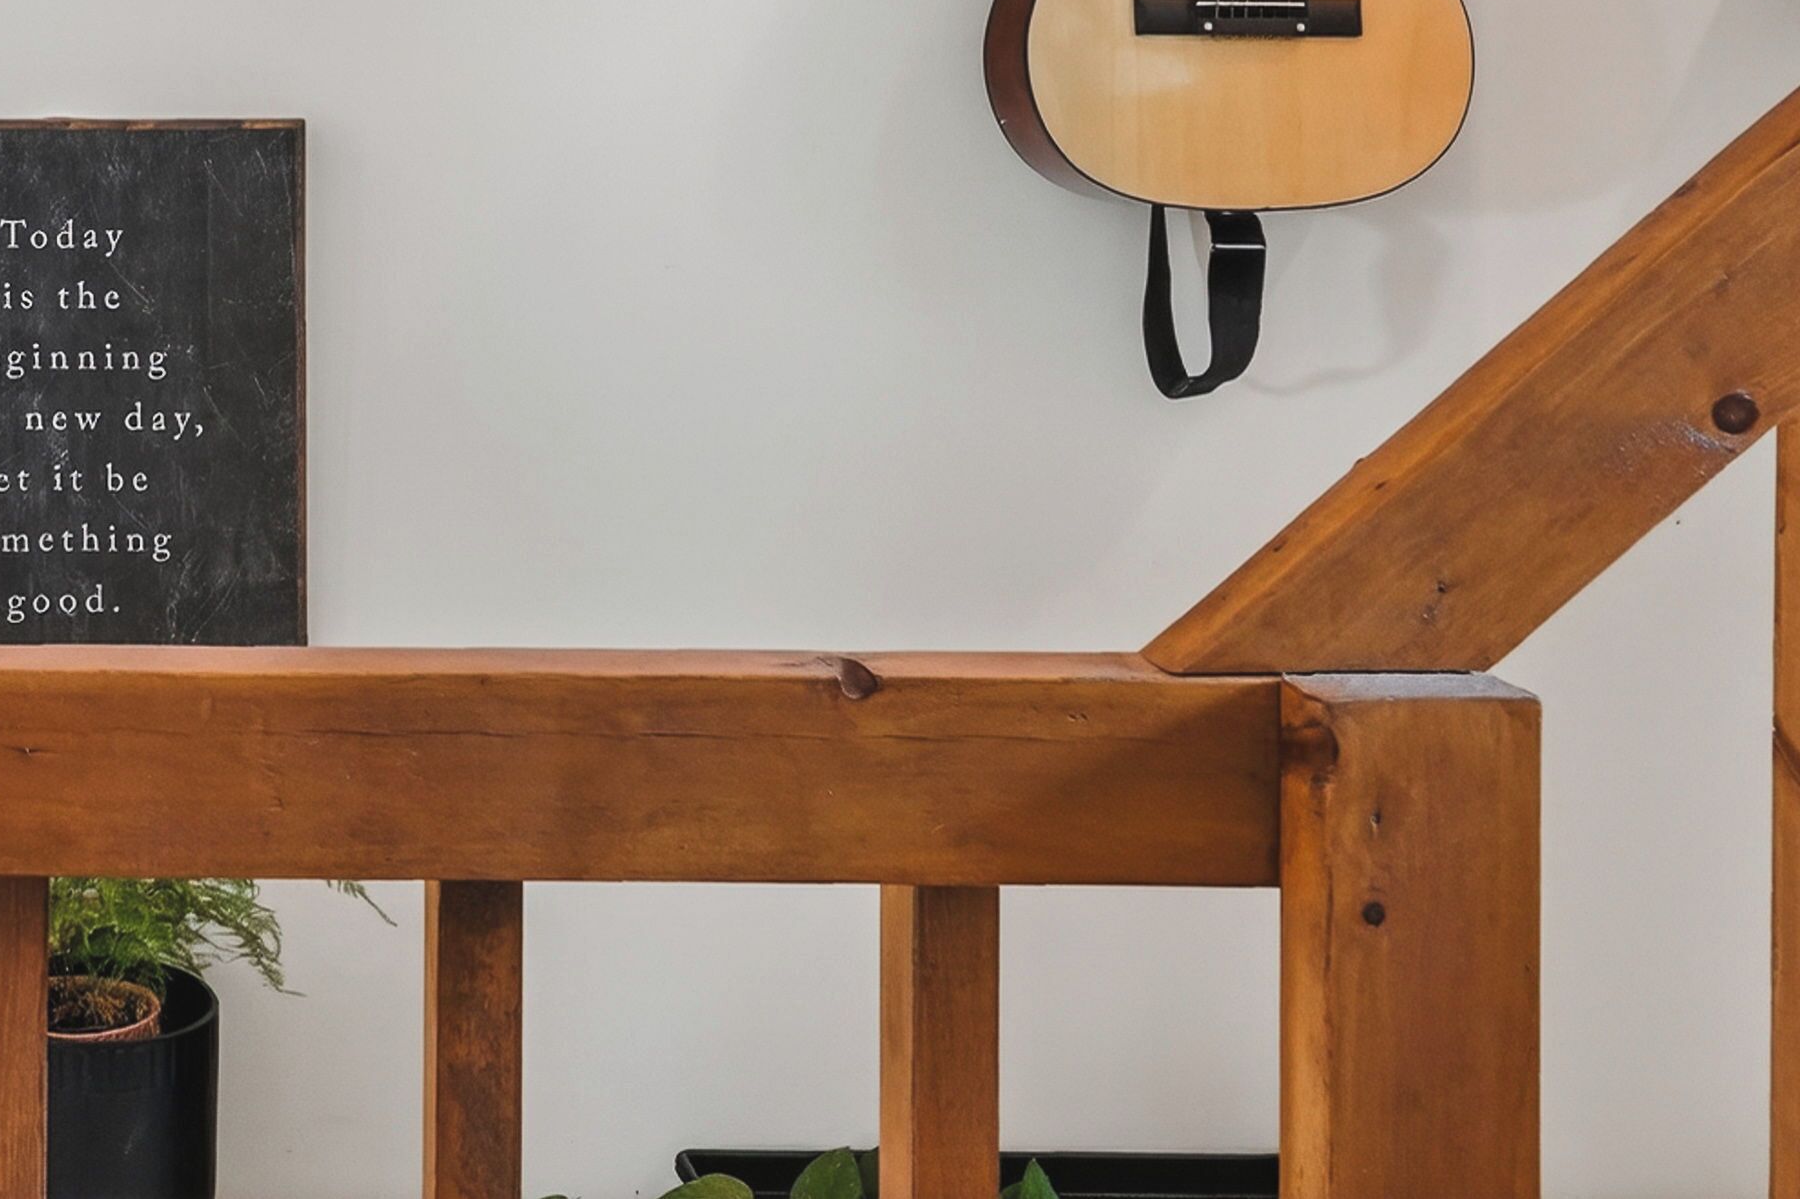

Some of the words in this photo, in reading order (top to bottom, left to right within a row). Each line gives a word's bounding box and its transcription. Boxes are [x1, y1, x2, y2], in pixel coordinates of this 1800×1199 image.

[0, 218, 124, 258] Today
[3, 282, 34, 310] is
[57, 280, 120, 310] the
[25, 411, 101, 431] new
[124, 401, 204, 441] day,
[53, 463, 83, 492] it
[106, 462, 148, 492] be
[6, 583, 120, 624] good.
